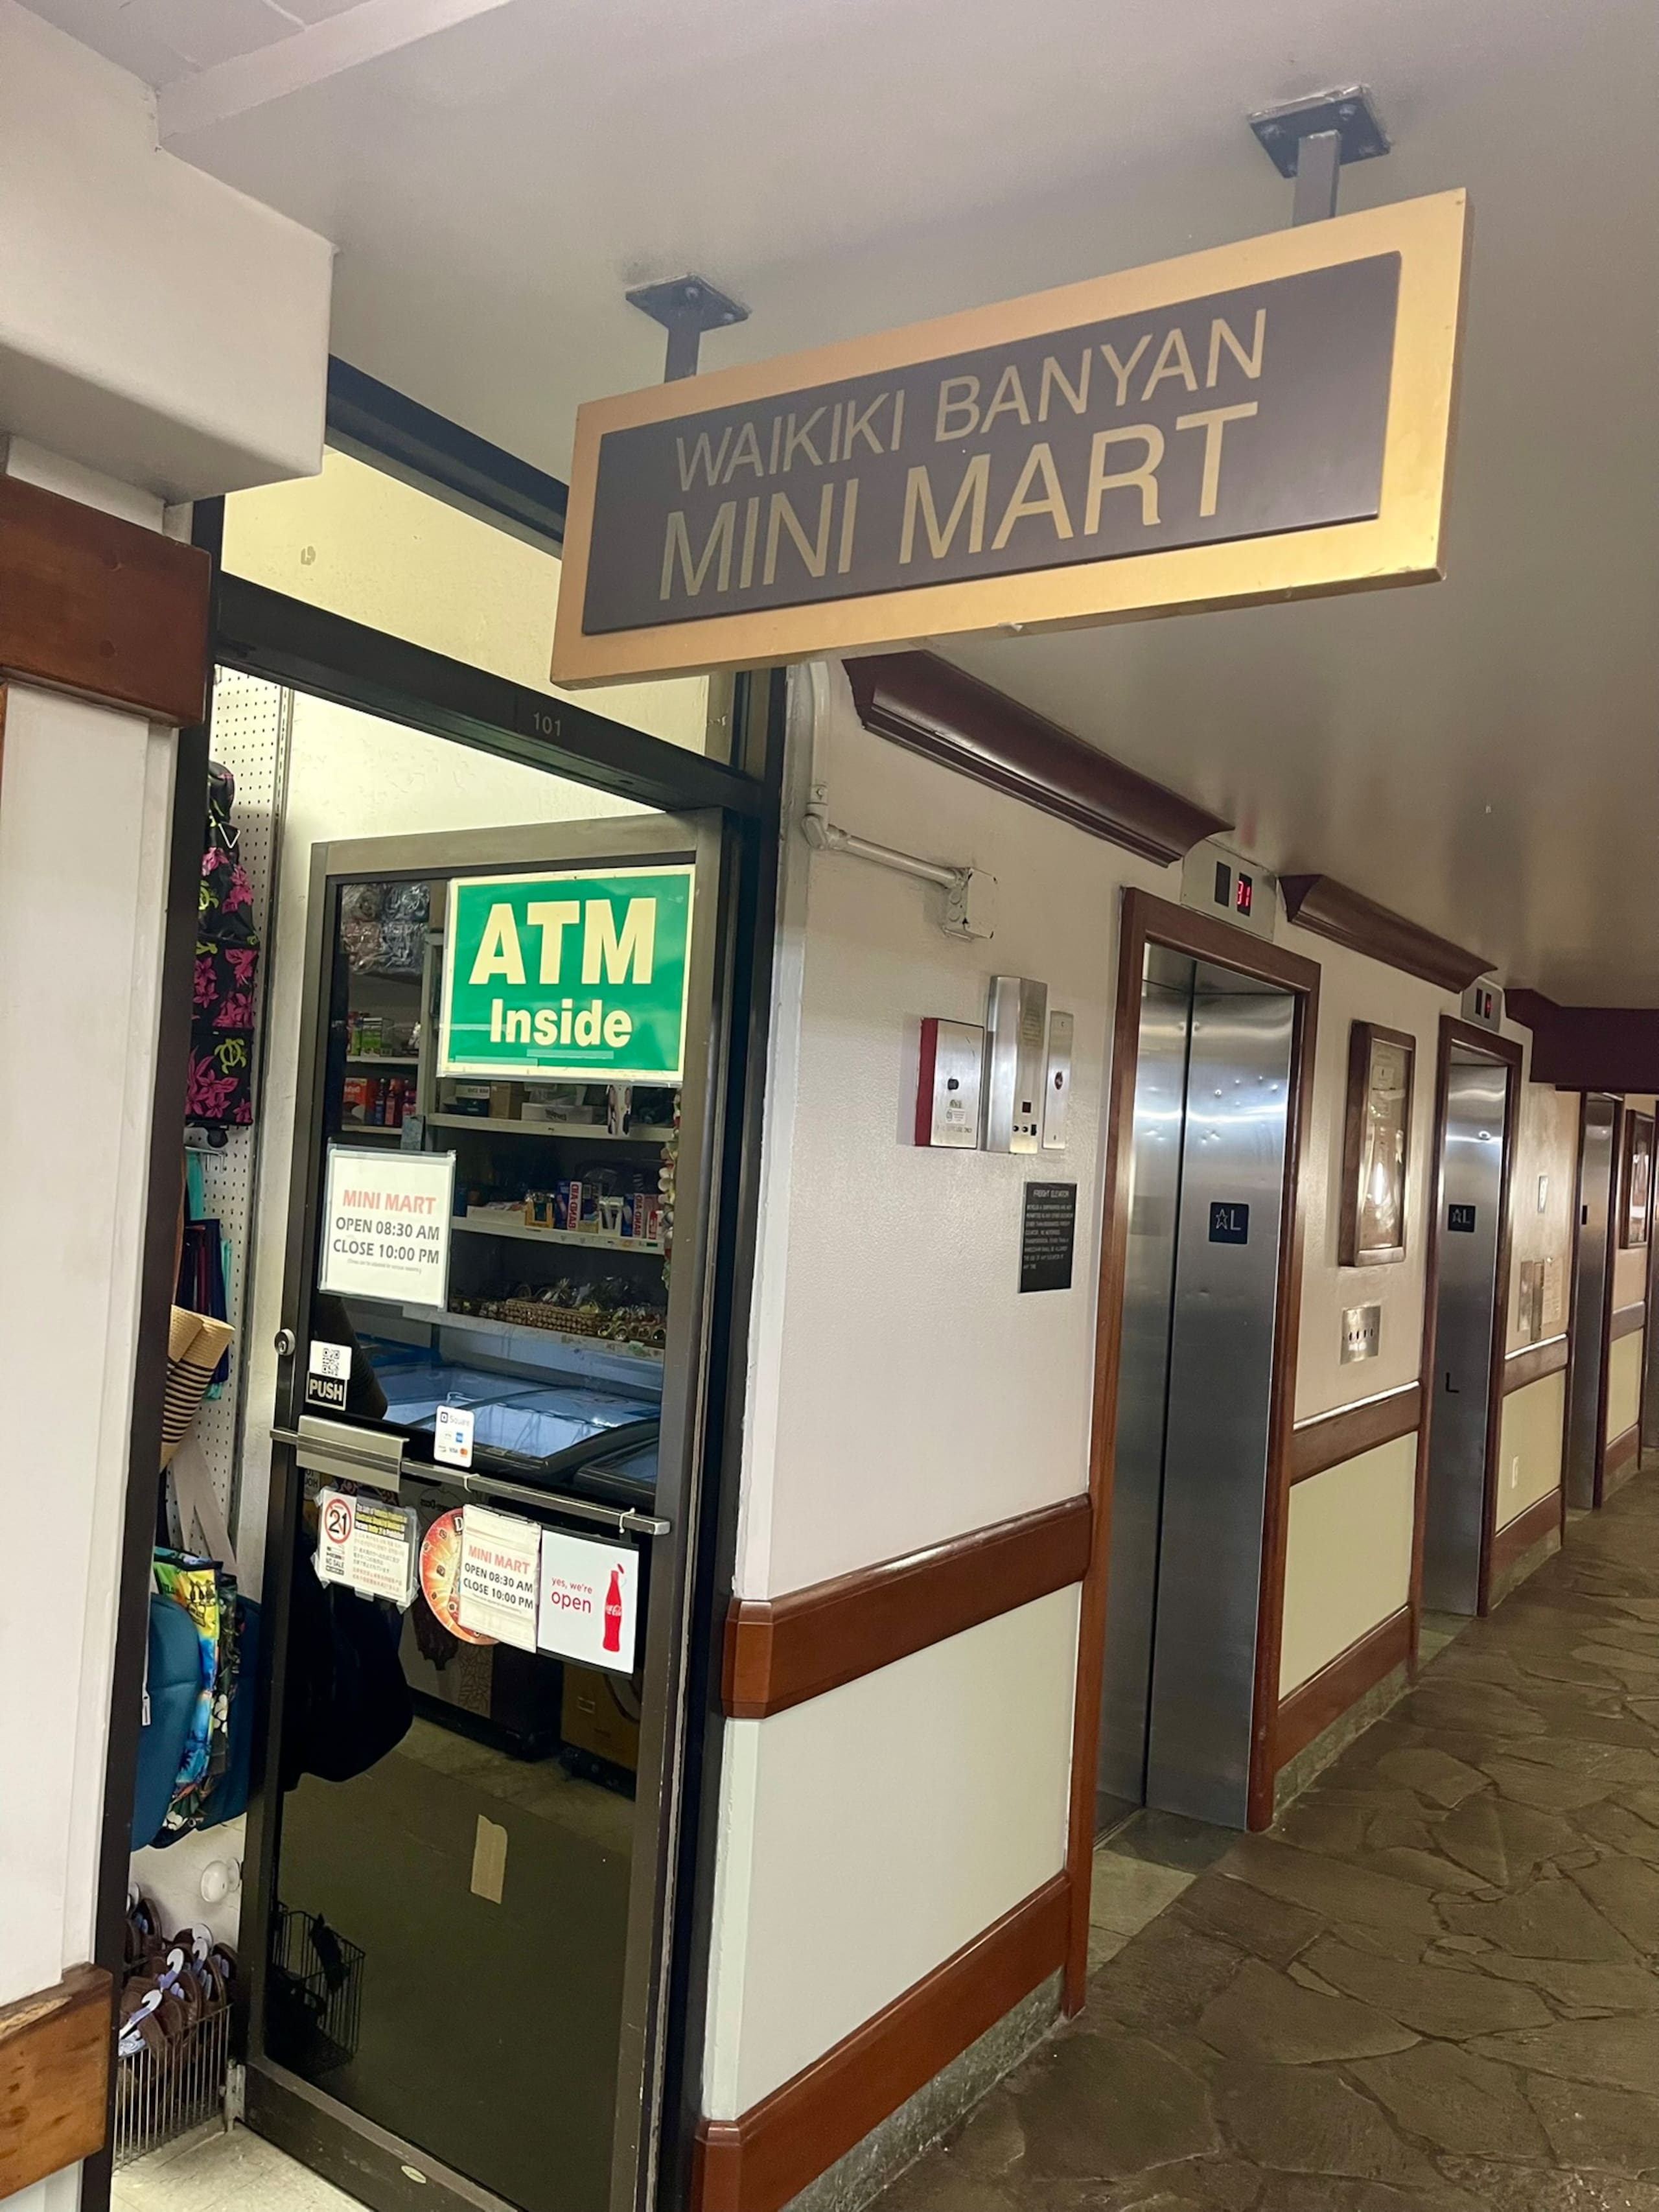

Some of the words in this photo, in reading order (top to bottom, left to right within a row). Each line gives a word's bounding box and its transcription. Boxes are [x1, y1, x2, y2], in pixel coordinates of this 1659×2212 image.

[675, 390, 905, 492] WAIKIKI
[934, 309, 1267, 443] BANYAN
[659, 478, 859, 602] MINI
[899, 401, 1259, 565] MART
[533, 712, 561, 736] 101
[468, 897, 656, 985] ATM
[490, 998, 633, 1048] Inside
[342, 1189, 381, 1211] MINI
[384, 1194, 436, 1215] MART
[336, 1217, 373, 1233] OPEN
[376, 1220, 413, 1238] 08:30
[415, 1225, 440, 1240] AM
[1230, 1209, 1242, 1231] L
[333, 1239, 374, 1257] CLOSE
[380, 1244, 415, 1261] 10:00
[418, 1248, 439, 1264] PM
[309, 1378, 343, 1402] PUSH
[1446, 1372, 1459, 1393] L
[329, 1509, 347, 1535] 21
[469, 1544, 492, 1564] MINI
[494, 1554, 530, 1575] MART
[465, 1563, 487, 1579] OPEN
[489, 1571, 515, 1587] 08:30
[516, 1580, 533, 1594] AM
[551, 1576, 568, 1589] yes,
[569, 1581, 593, 1594] we're
[463, 1578, 489, 1596] CLOSE
[492, 1588, 516, 1604] 10:00
[518, 1596, 533, 1610] PM
[551, 1592, 591, 1613] open
